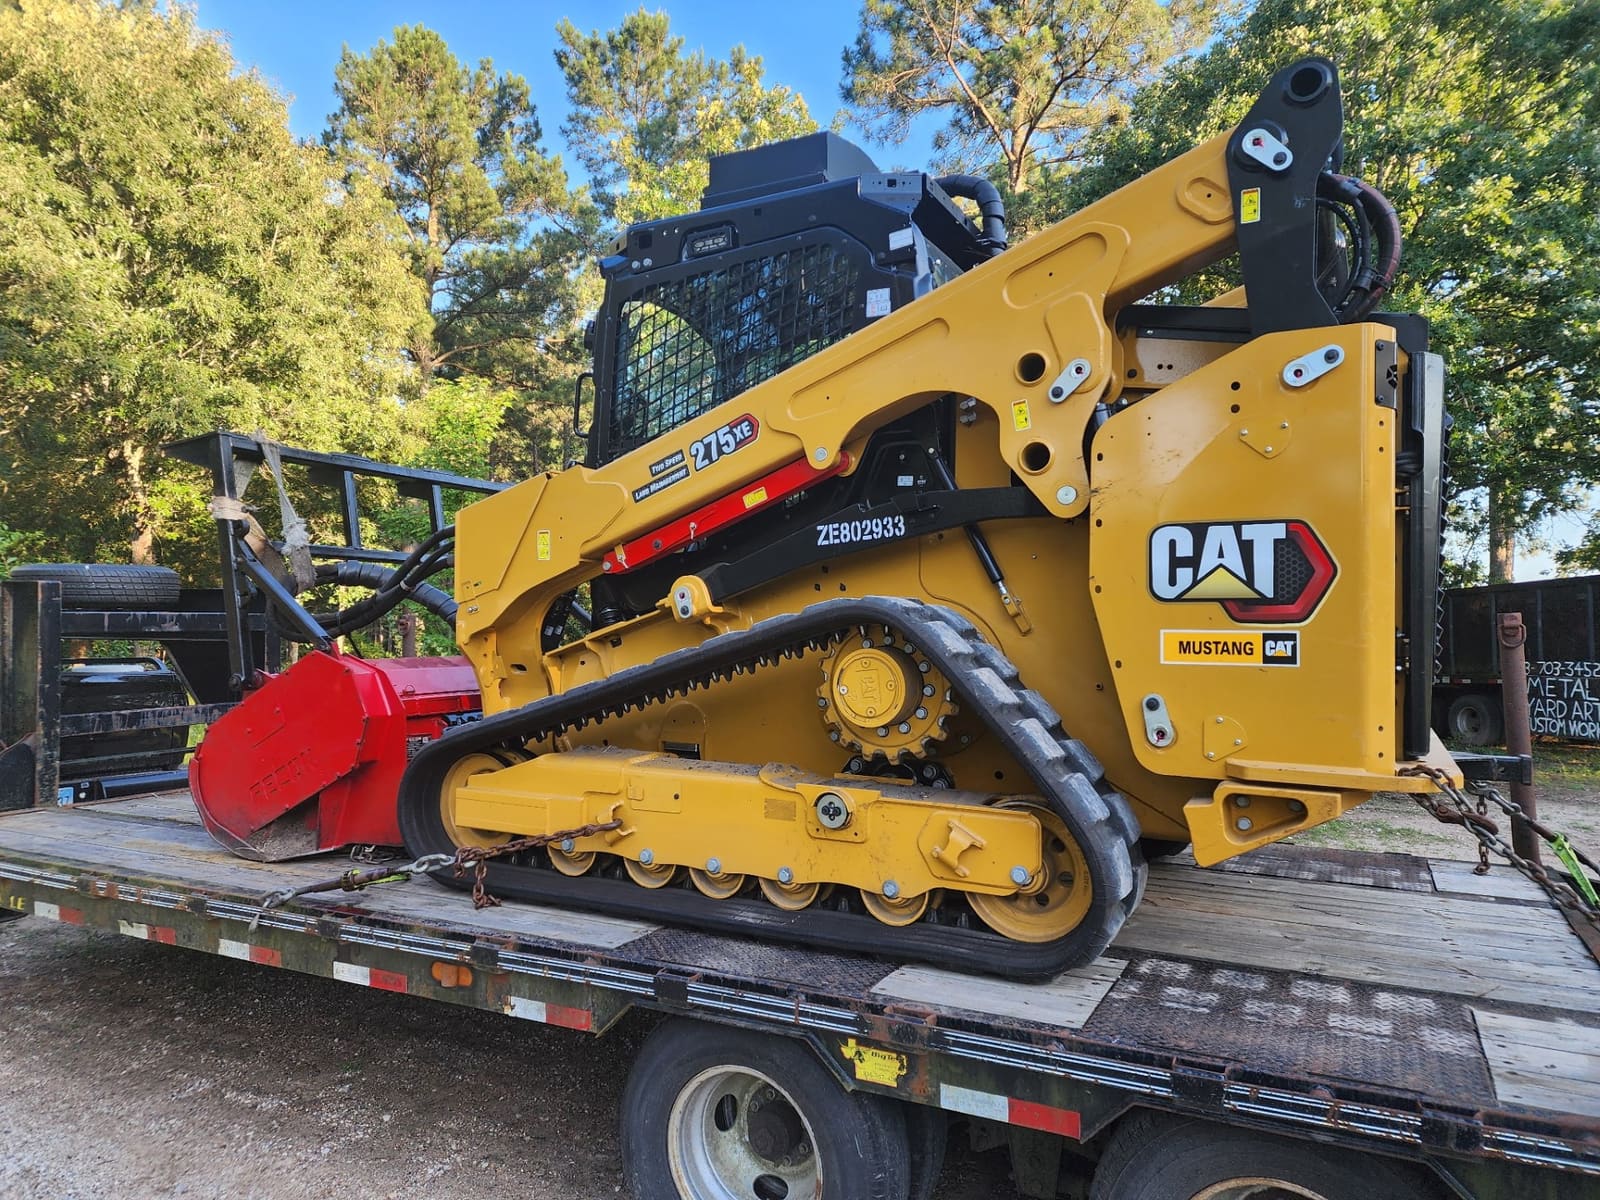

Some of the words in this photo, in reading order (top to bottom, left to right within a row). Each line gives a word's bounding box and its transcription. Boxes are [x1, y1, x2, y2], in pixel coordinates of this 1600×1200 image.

[816, 515, 905, 546] ZE802933
[1151, 522, 1287, 600] CAT
[1178, 640, 1254, 656] MUSTANG
[1264, 639, 1296, 657] CAT
[1527, 677, 1600, 702] METAL
[1529, 717, 1567, 736] USTOM
